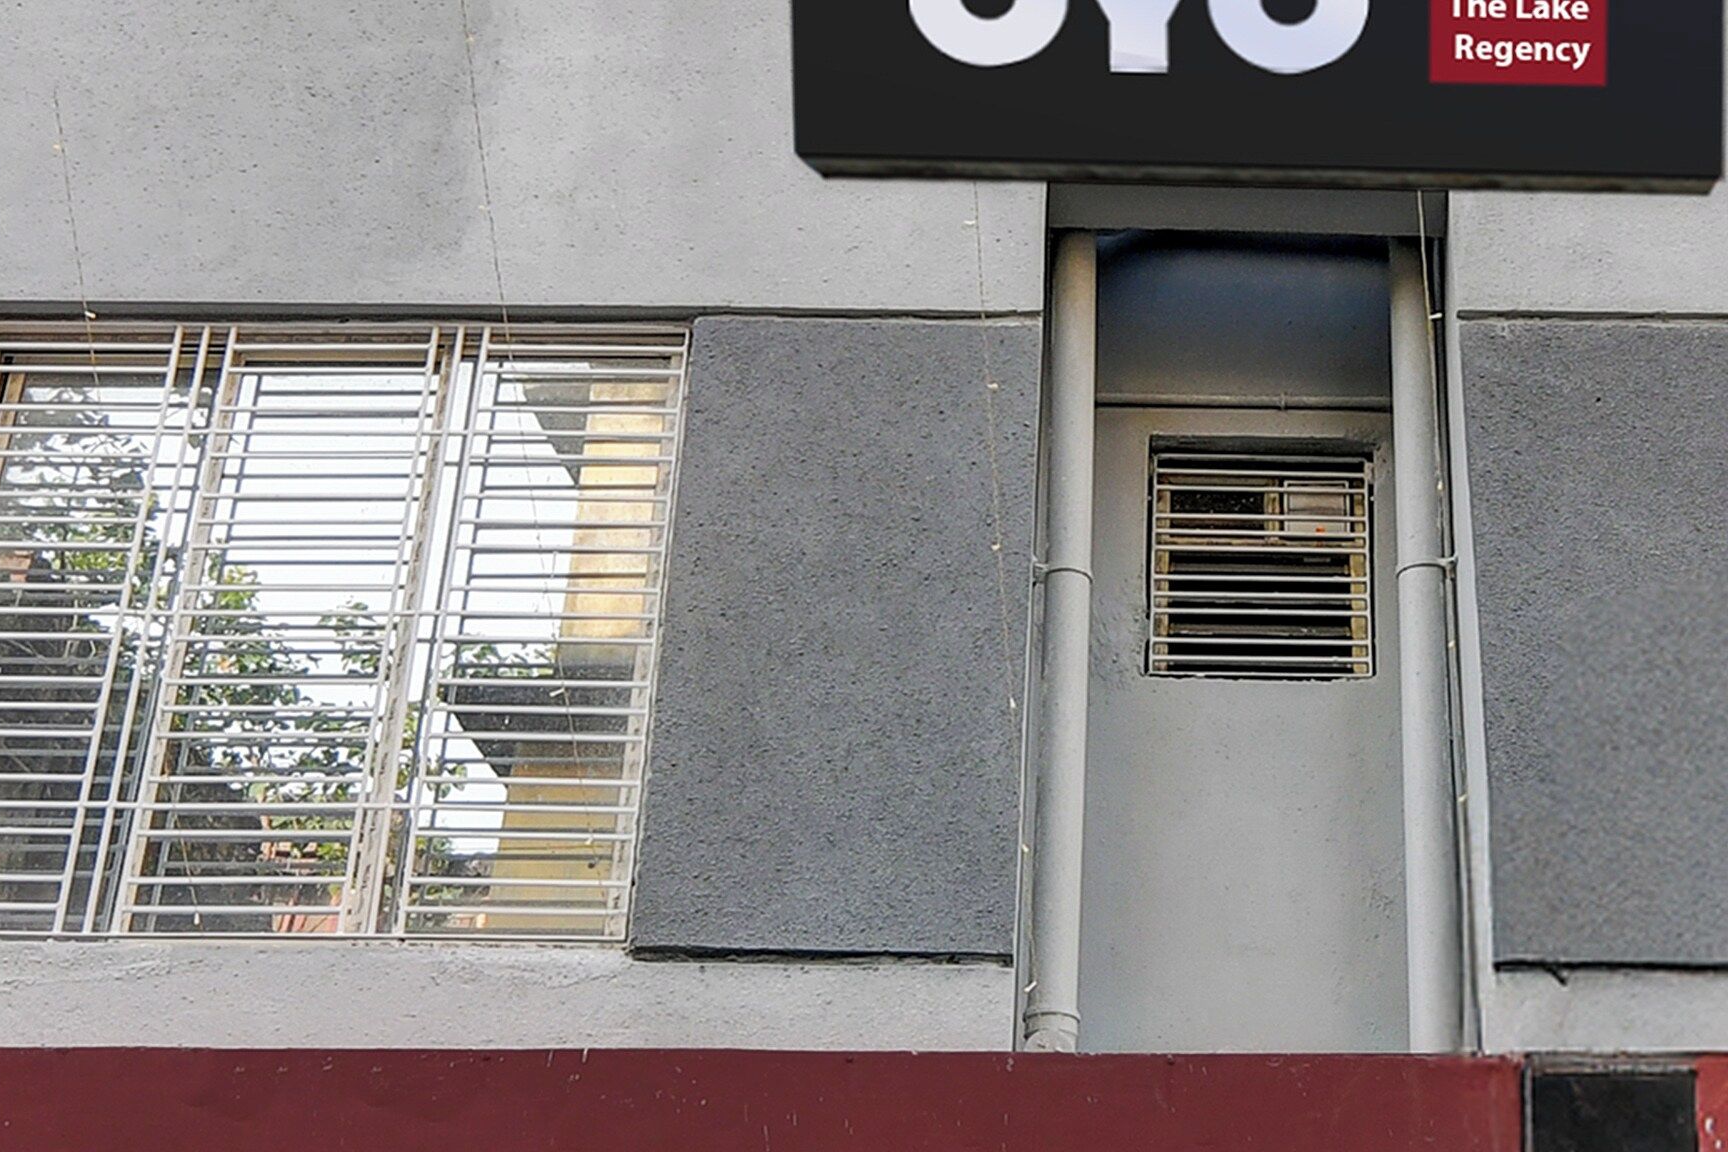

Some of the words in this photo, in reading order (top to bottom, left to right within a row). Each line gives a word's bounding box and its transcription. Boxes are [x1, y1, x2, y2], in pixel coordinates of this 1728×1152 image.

[1452, 0, 1507, 18] The
[1516, 0, 1590, 20] Lake
[1454, 33, 1591, 70] Regency
